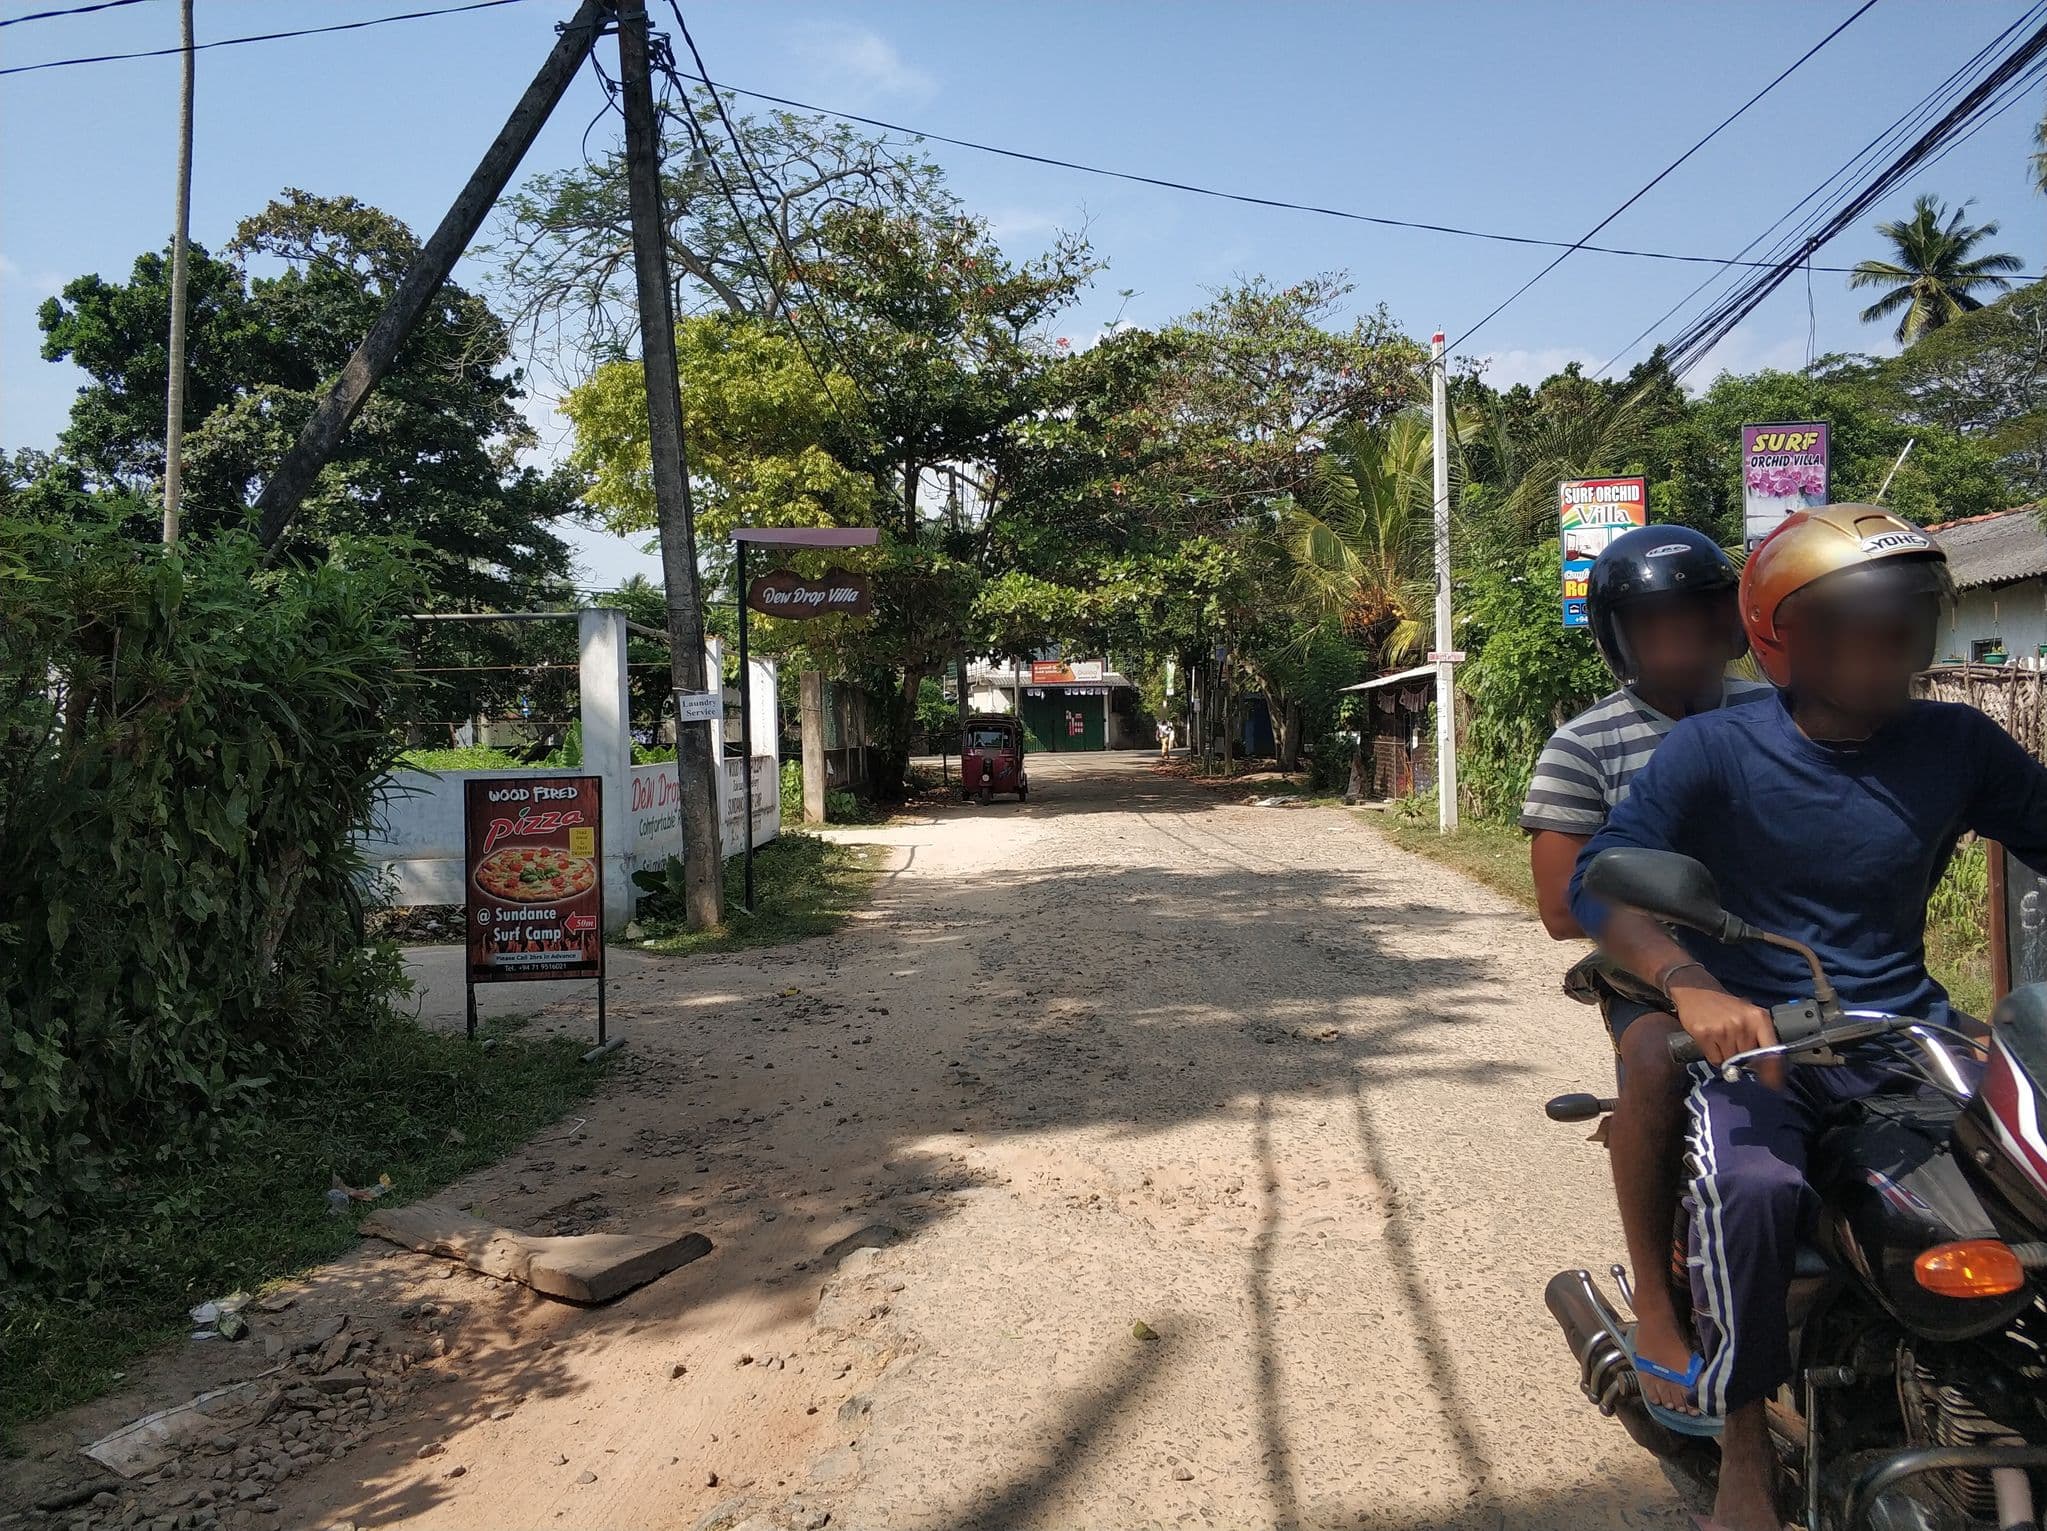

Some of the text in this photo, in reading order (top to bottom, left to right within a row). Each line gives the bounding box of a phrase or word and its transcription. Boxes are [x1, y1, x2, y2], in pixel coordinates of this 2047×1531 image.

[1751, 432, 1819, 452] SURF
[1751, 454, 1820, 468] ORCHID VILLA
[1564, 485, 1640, 504] SURF ORCHID
[1576, 505, 1632, 524] Villa
[763, 587, 860, 607] Dew Drop Villa
[682, 699, 716, 708] Laundry
[686, 708, 716, 717] Service
[488, 786, 578, 803] WOOD FIRED
[483, 806, 584, 854] pizza
[477, 906, 557, 925] @ Sundance
[576, 919, 594, 927] 50m
[493, 926, 562, 942] Surf Camp
[550, 952, 576, 960] Advance
